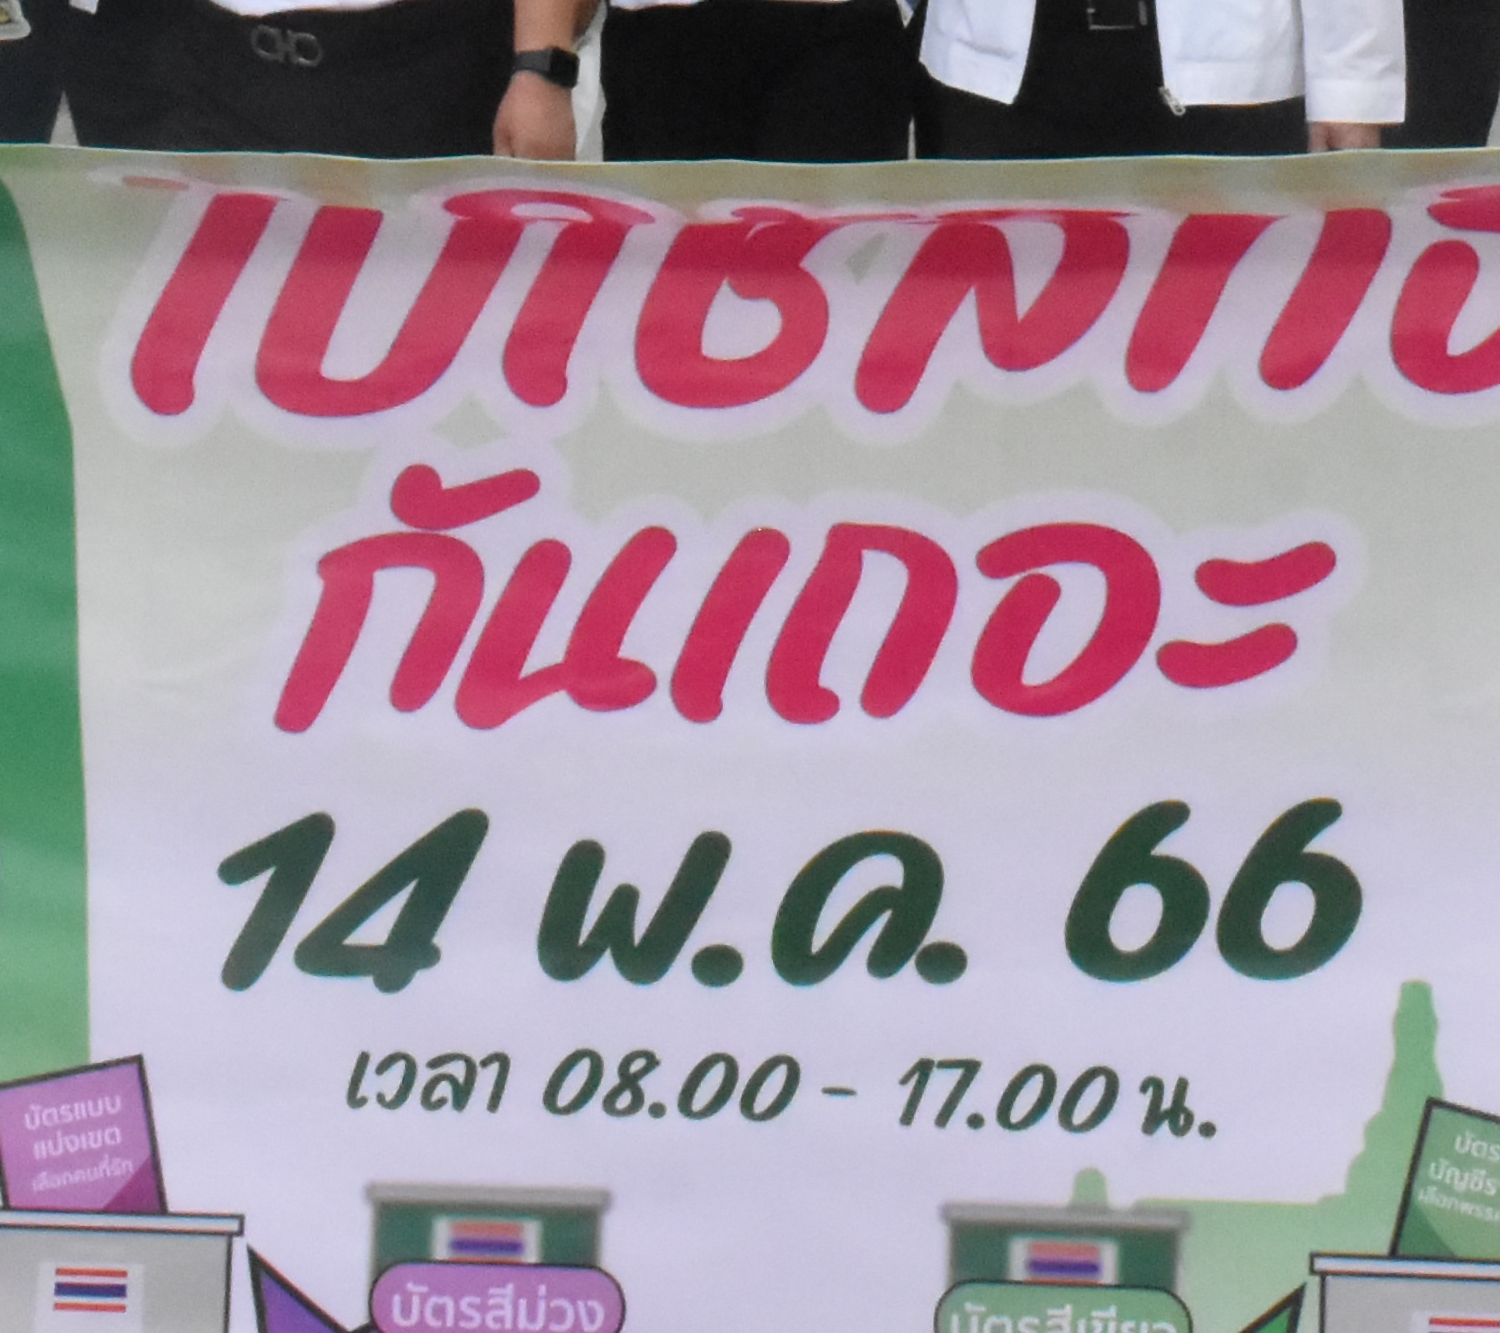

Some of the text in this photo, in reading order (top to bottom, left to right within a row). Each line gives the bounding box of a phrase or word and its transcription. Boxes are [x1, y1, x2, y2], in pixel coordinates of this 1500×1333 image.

[272, 461, 1340, 735] กันเถอะ
[216, 796, 1364, 995] 14 พ.ค. 66
[345, 1049, 512, 1114] เวลา
[541, 1048, 801, 1123] 08.00
[897, 1056, 1119, 1133] 17.00
[1140, 1074, 1218, 1138] น.
[391, 1285, 607, 1332] บัตรสีม่วง
